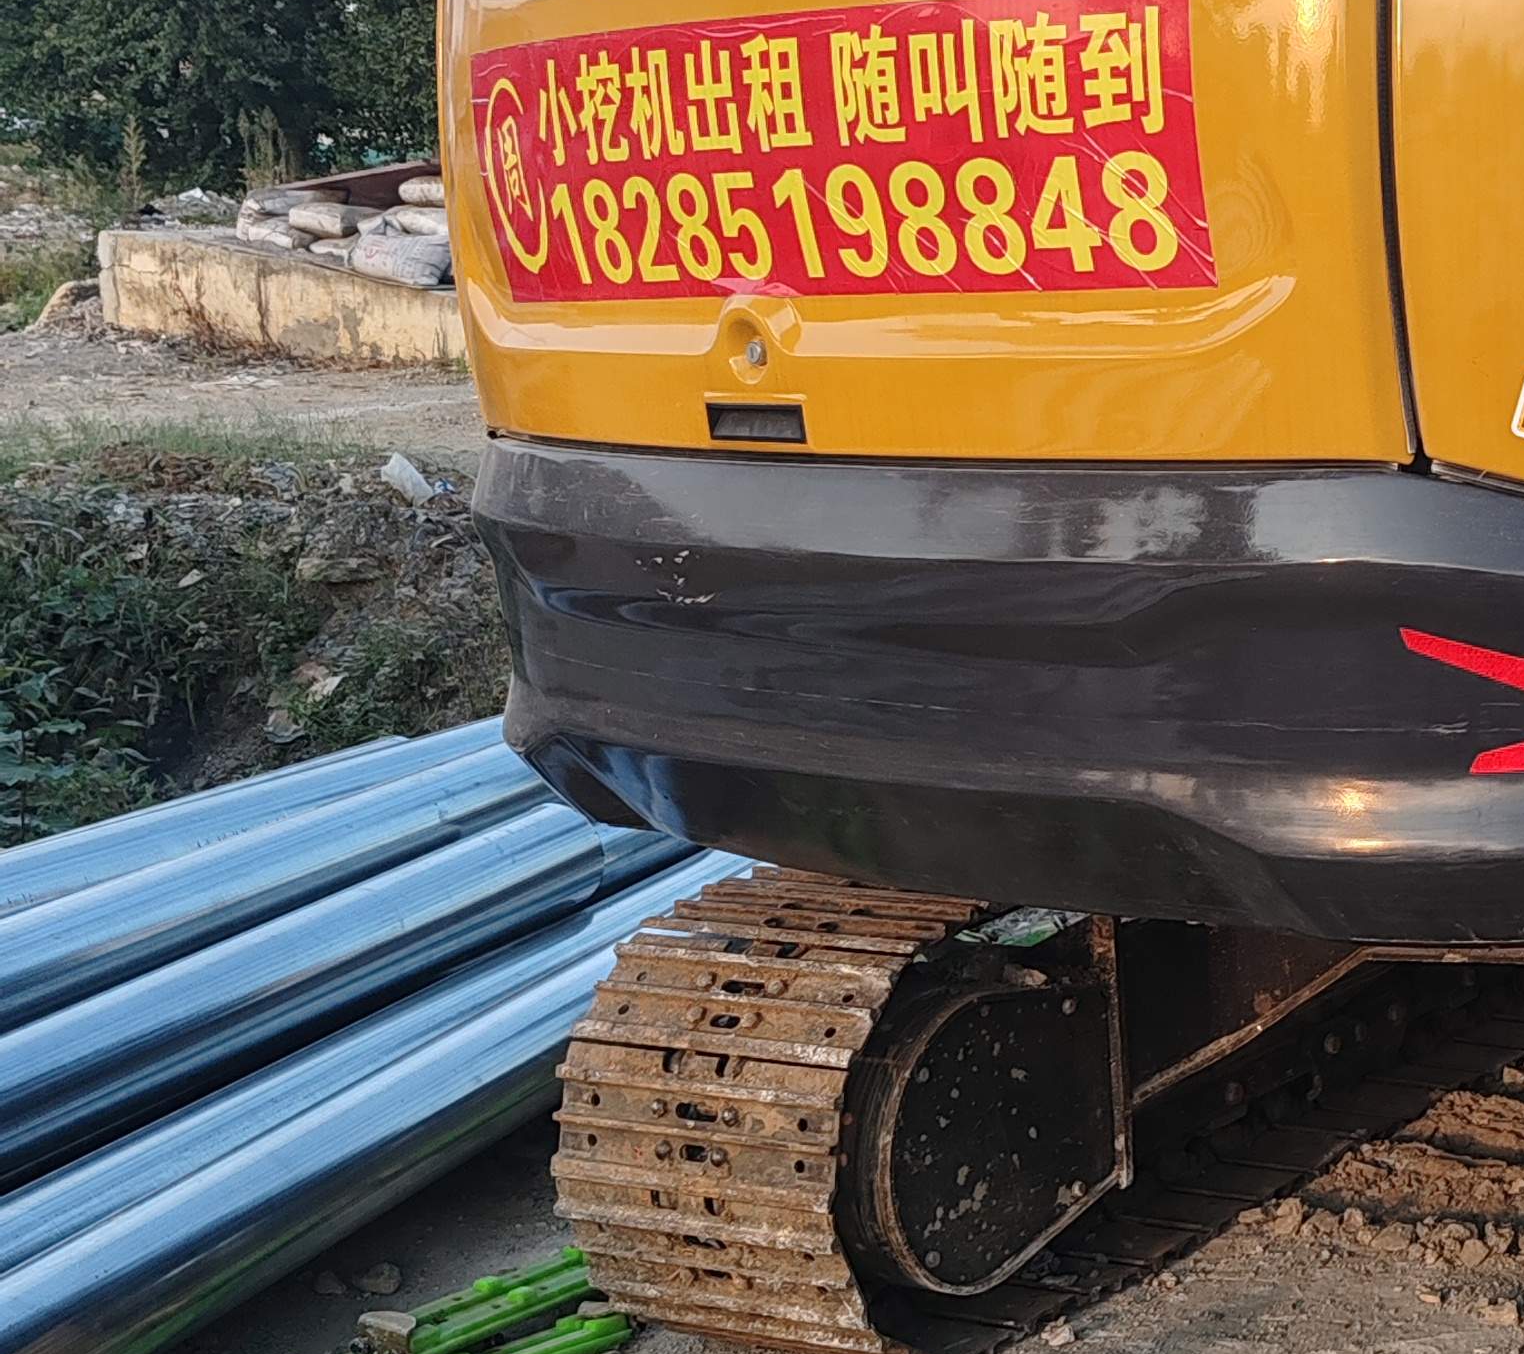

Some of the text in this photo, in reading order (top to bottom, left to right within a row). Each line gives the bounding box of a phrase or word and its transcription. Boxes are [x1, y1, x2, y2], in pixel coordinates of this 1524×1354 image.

[538, 5, 1165, 167] 小挖机出租 随叫随到
[549, 150, 1179, 286] 18285198848
